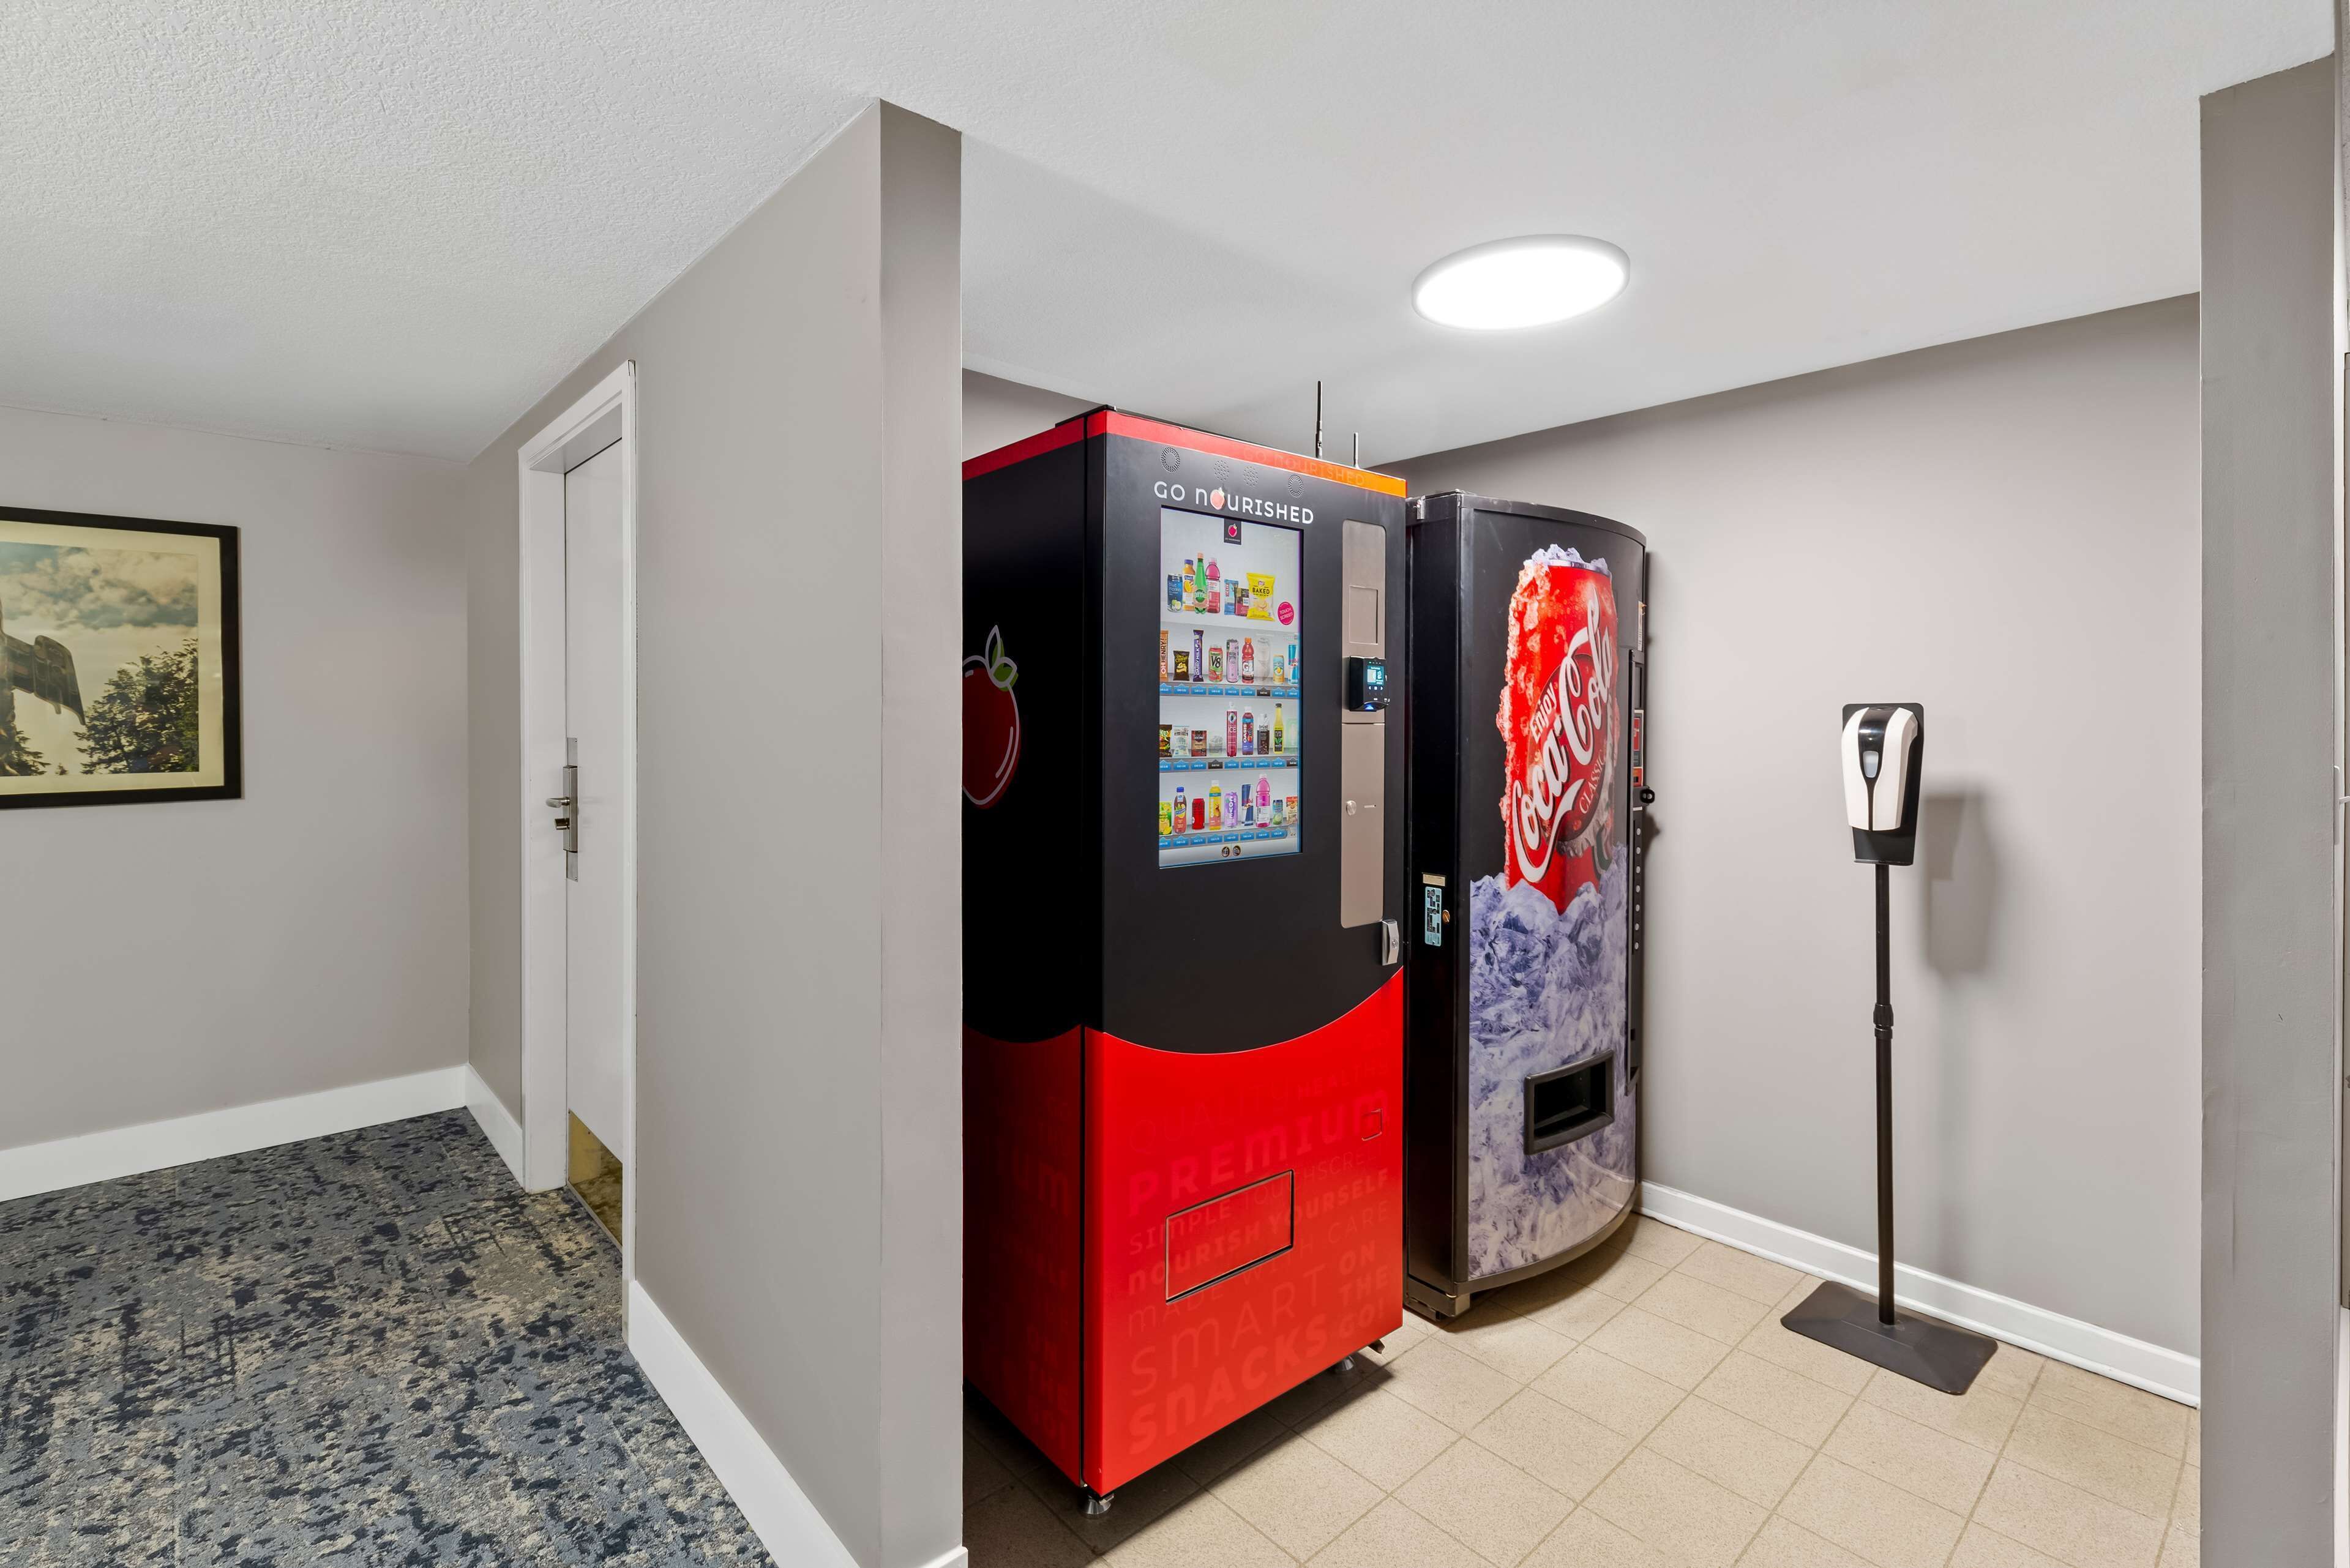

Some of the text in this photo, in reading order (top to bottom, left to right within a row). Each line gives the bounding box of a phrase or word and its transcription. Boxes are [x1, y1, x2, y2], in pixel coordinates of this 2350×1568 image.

[1243, 448, 1266, 461] GO
[1154, 480, 1185, 501] GO
[1161, 663, 1166, 674] OH
[1211, 655, 1221, 668] V8
[1512, 587, 1612, 883] Coca-Cola
[1530, 682, 1557, 744] Enjoy
[1579, 752, 1606, 815] CLASSIC
[1130, 1060, 1389, 1155] QUALITY HEALTHY
[1128, 1086, 1389, 1217] PREMIUM
[1267, 1168, 1388, 1234] YOURSELF
[1327, 1200, 1389, 1244] CARE
[1339, 1264, 1389, 1308] THE
[1131, 1263, 1327, 1397] SMART
[1339, 1239, 1376, 1276] ON
[1128, 1313, 1328, 1455] SNACKS
